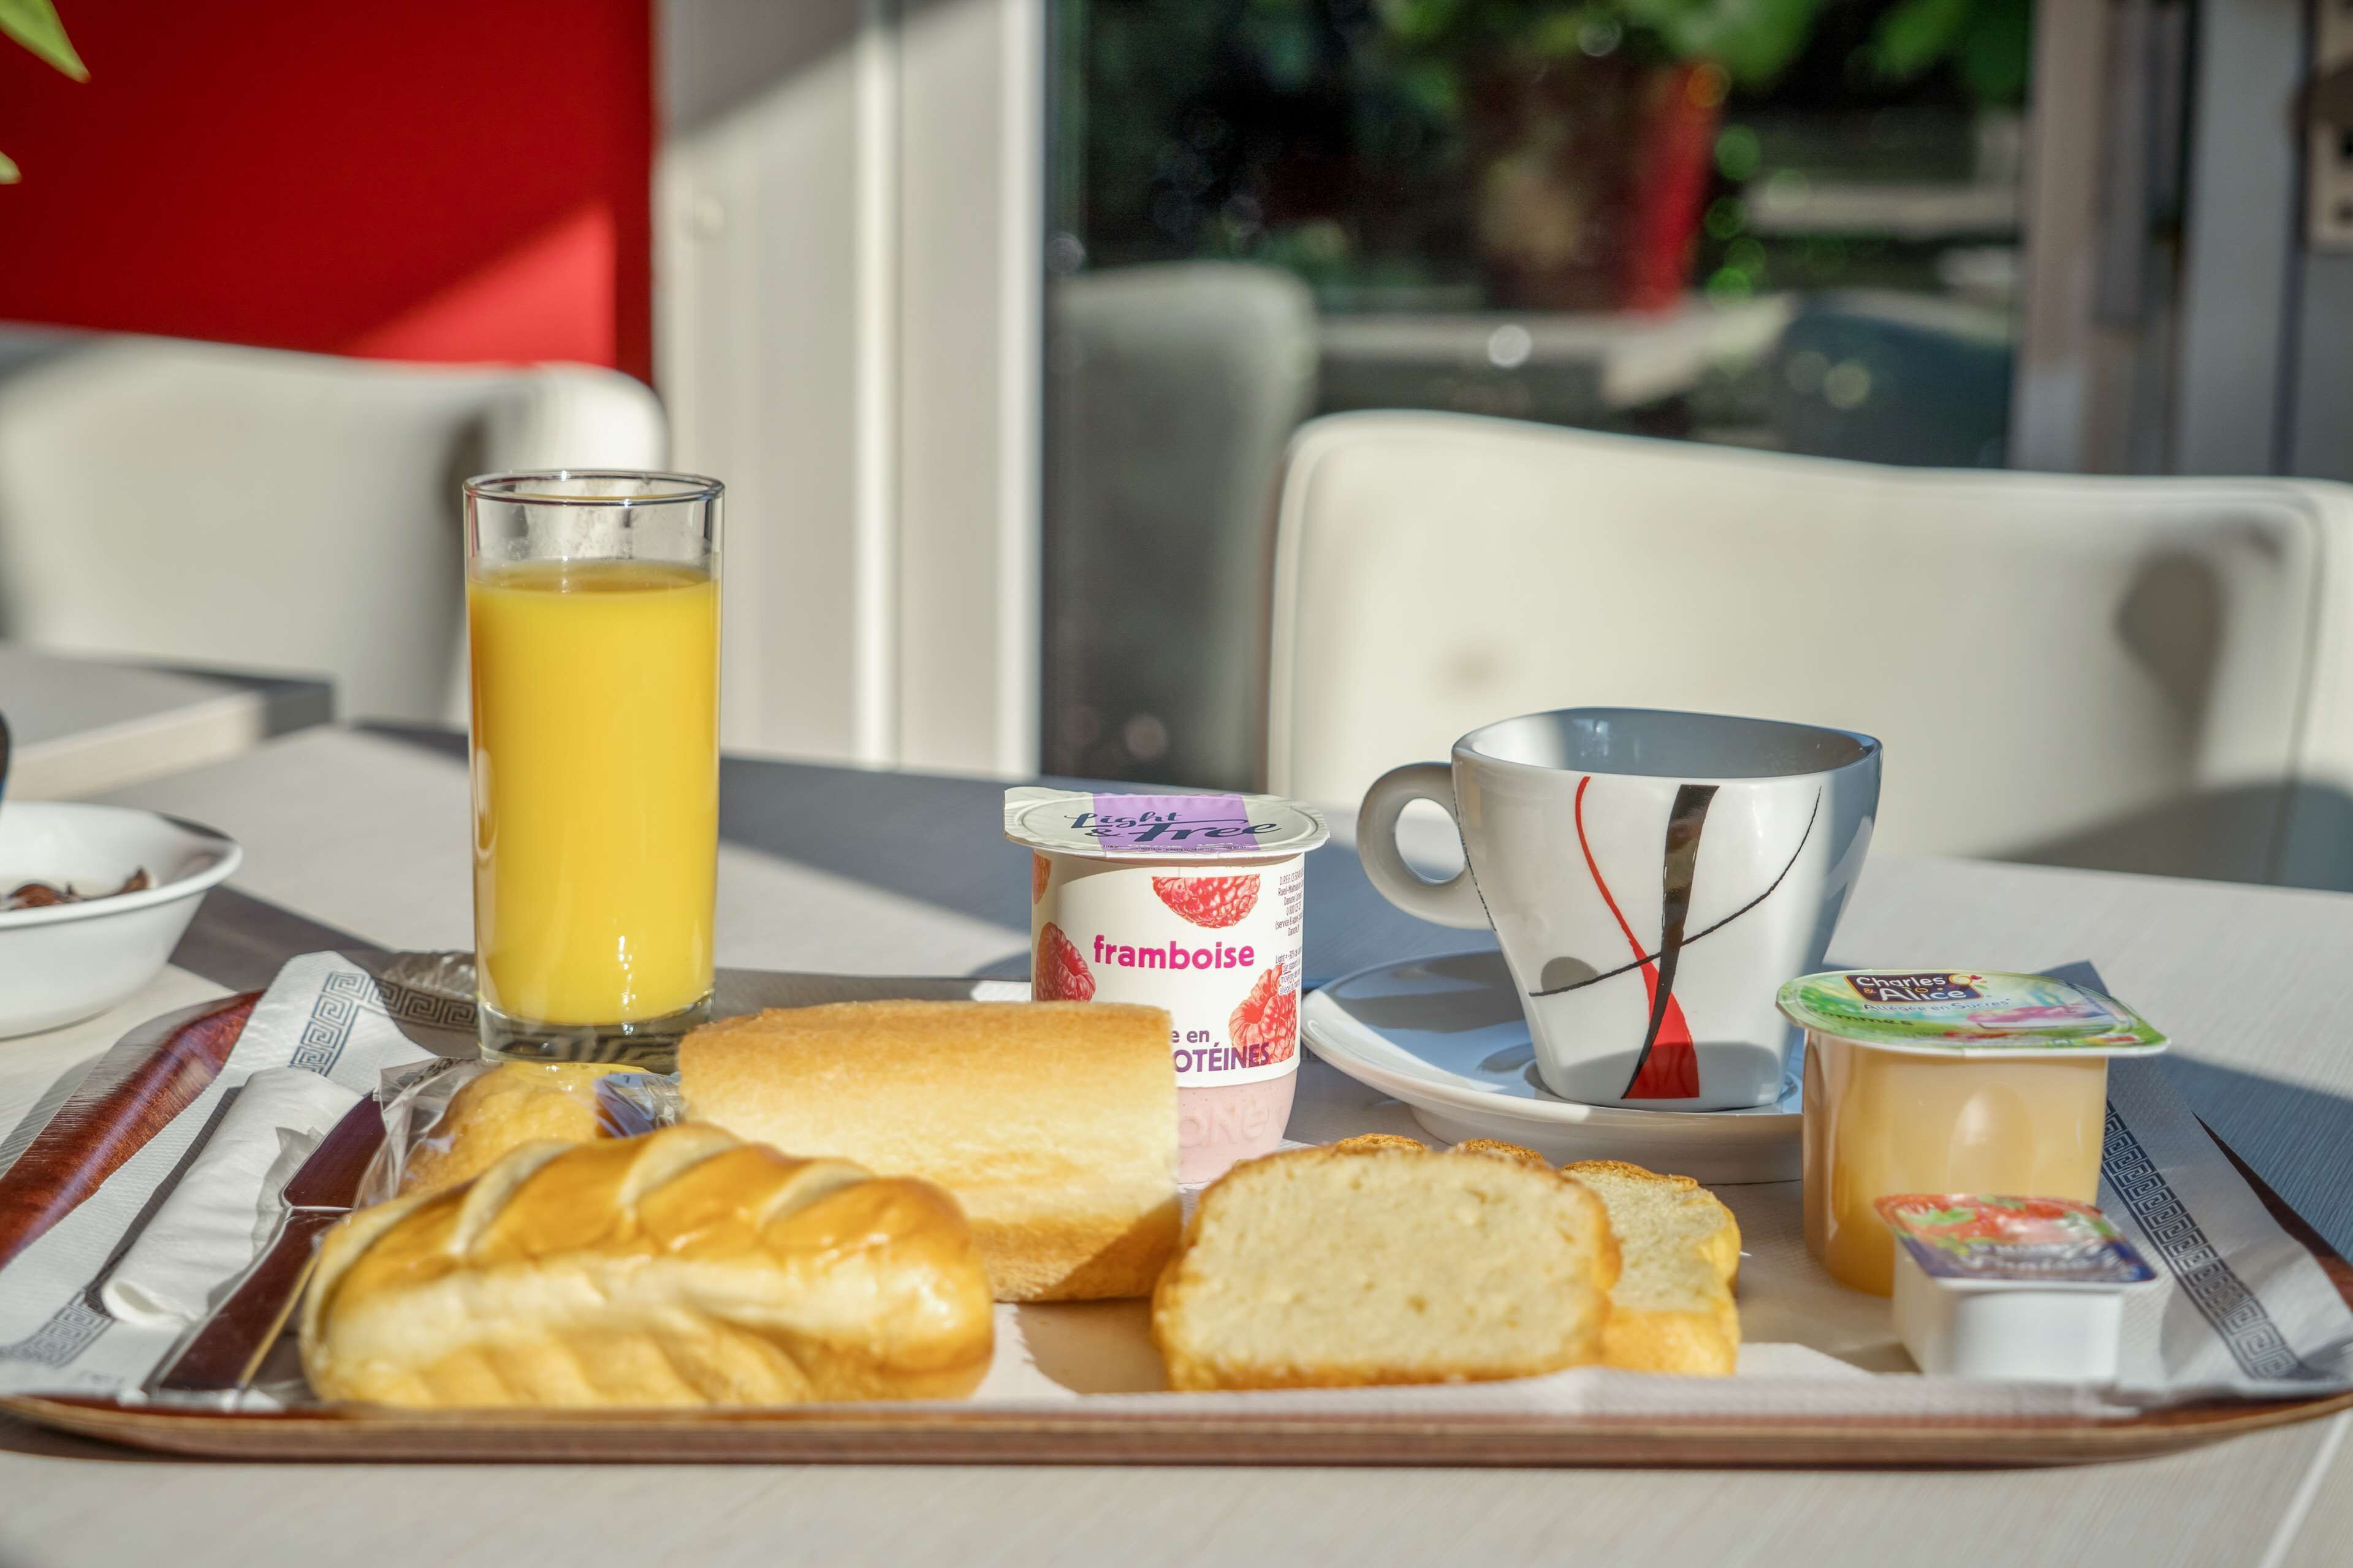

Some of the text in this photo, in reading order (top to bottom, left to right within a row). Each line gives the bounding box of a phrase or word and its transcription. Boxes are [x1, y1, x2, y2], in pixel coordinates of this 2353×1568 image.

[1064, 811, 1182, 829] Light
[1084, 819, 1282, 843] & Free
[1093, 934, 1255, 970] framboise
[1856, 976, 1947, 988] Charles
[1879, 987, 1967, 1002] Alice
[1186, 1030, 1210, 1043] en
[1173, 1042, 1270, 1073] OTÉINES
